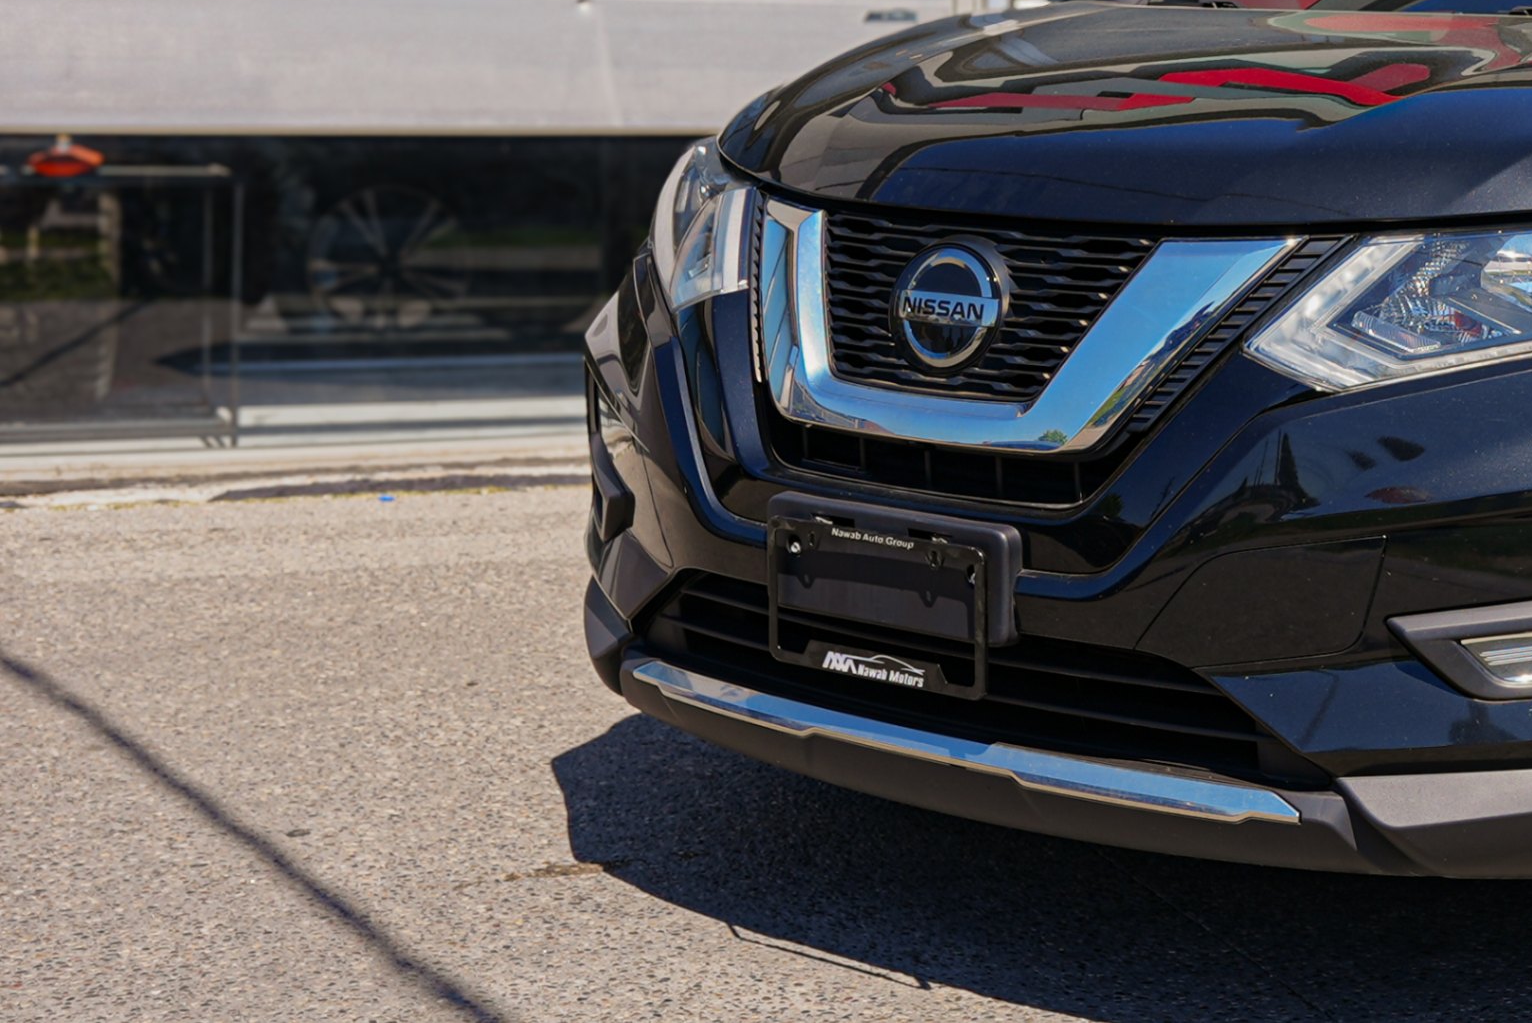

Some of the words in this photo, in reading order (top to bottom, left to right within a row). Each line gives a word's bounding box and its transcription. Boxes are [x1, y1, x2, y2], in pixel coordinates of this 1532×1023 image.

[903, 296, 984, 320] NISSAN
[831, 527, 862, 540] Nawab
[862, 533, 884, 544] Auto
[885, 536, 915, 551] Group
[857, 663, 888, 681] Nawab
[888, 669, 925, 688] Motors
